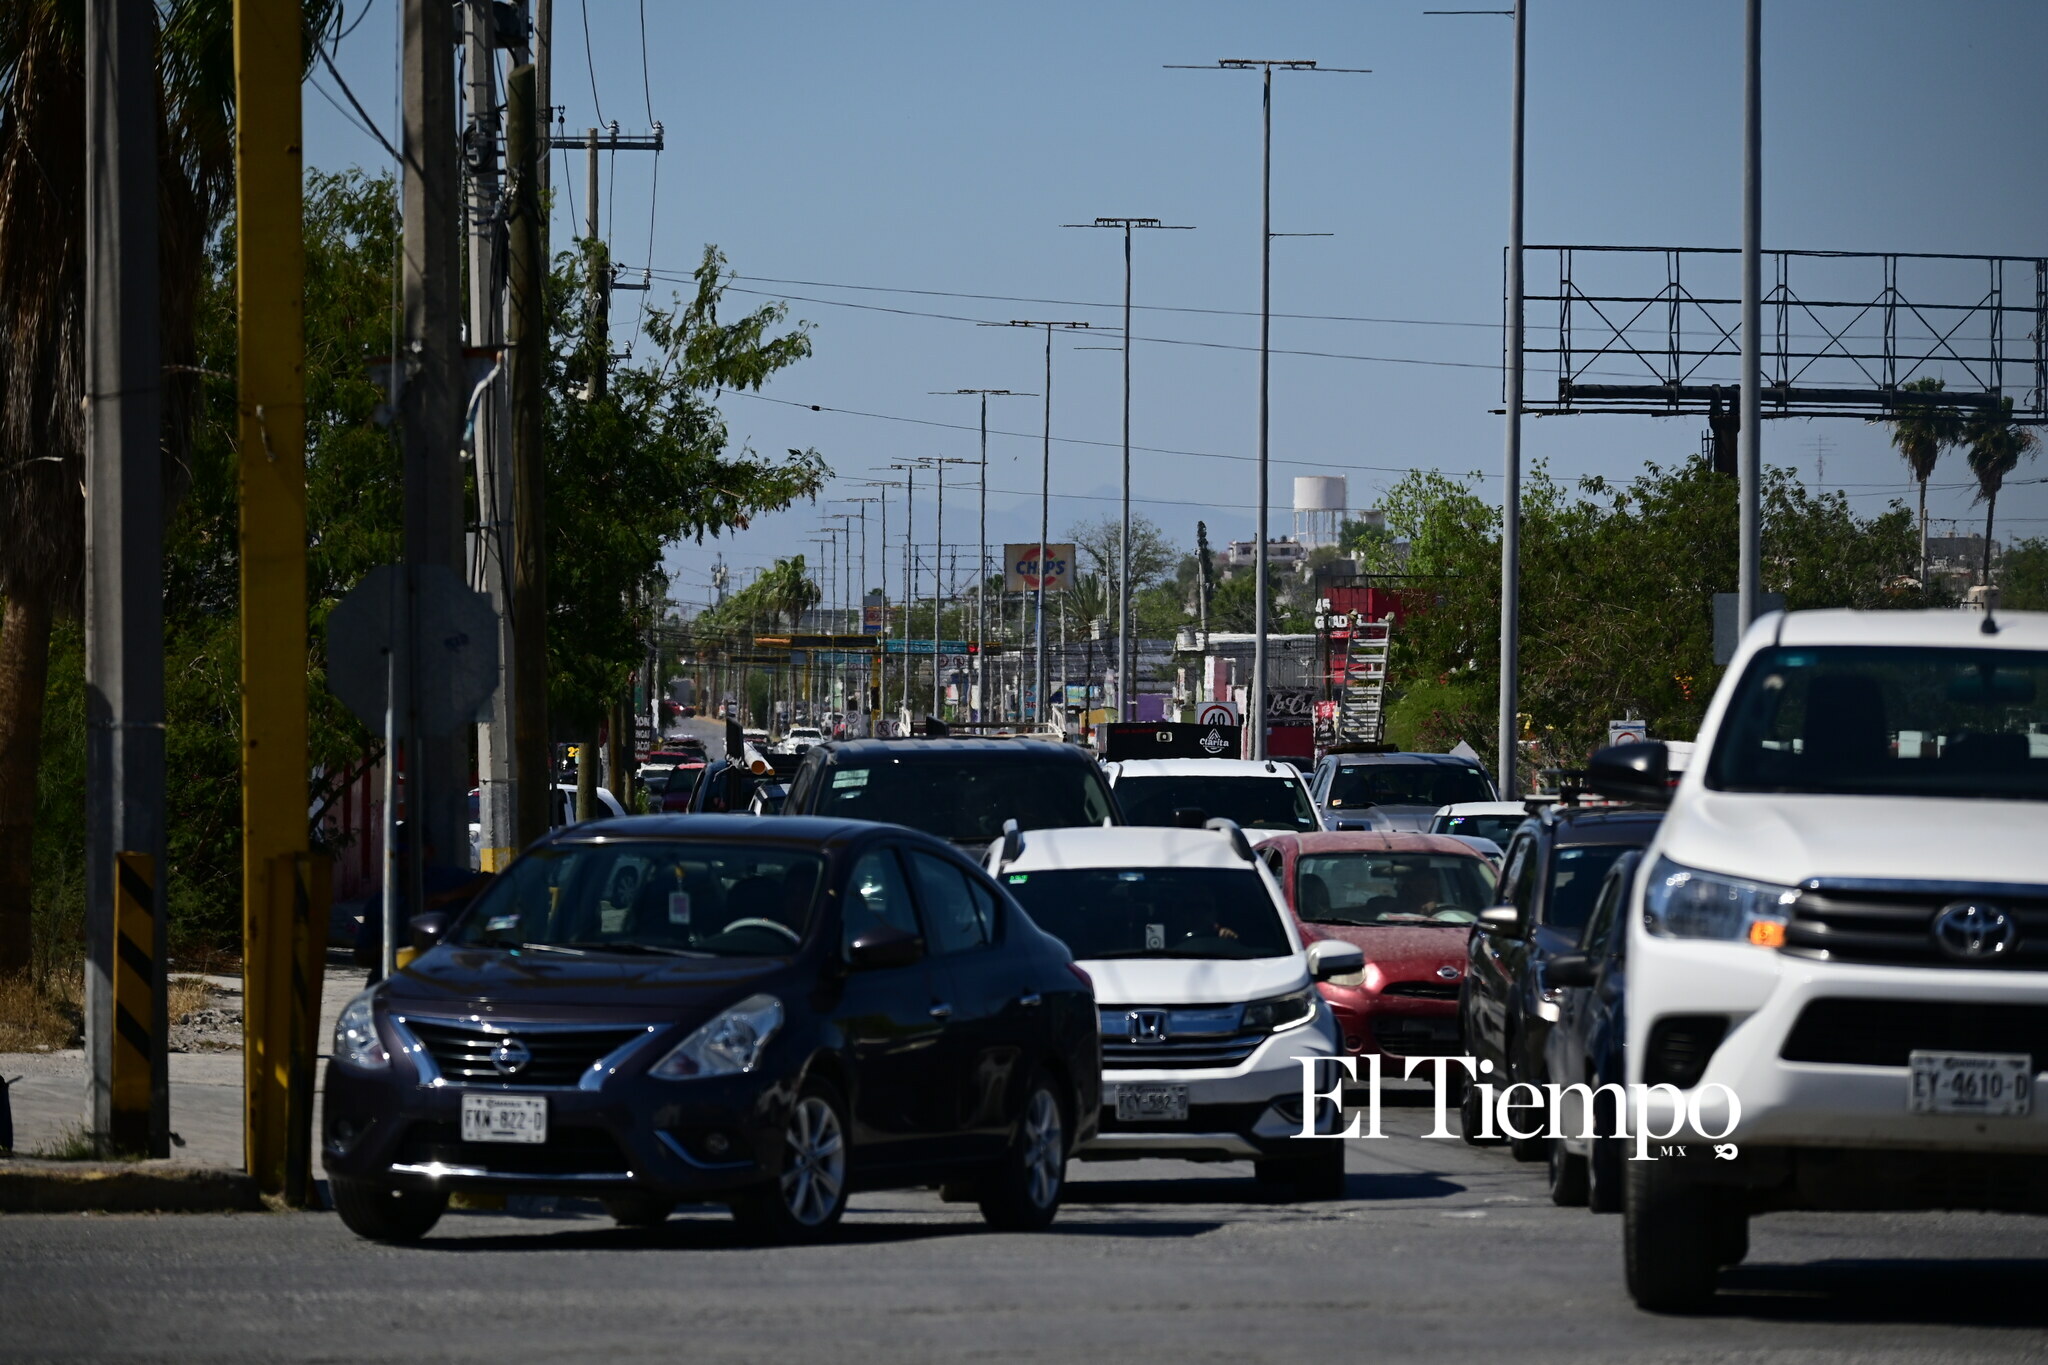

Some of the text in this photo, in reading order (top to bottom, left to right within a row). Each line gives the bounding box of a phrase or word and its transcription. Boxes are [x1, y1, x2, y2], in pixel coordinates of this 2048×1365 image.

[1015, 560, 1066, 575] CHPS
[1314, 613, 1364, 630] GADS
[1208, 712, 1226, 725] 40
[1912, 1070, 2029, 1101] EY-4610-D
